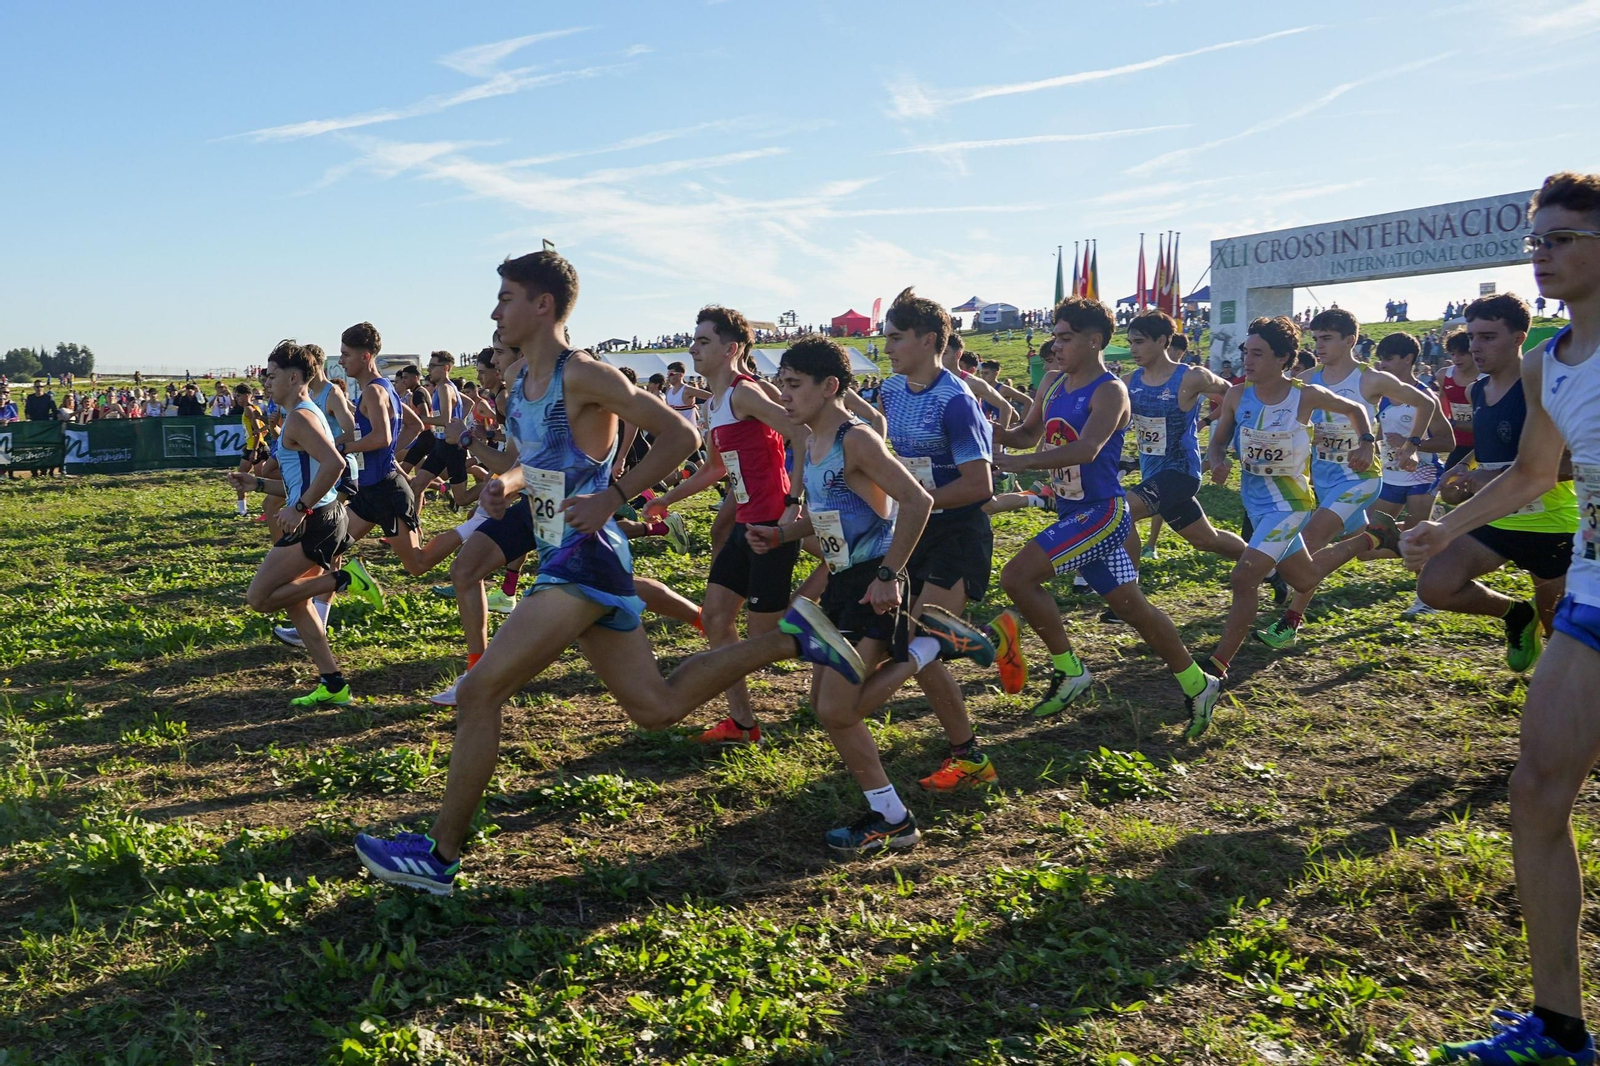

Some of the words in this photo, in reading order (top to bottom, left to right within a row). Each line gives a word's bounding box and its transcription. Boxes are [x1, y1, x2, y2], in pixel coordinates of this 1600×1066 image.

[1215, 242, 1249, 270] XLI
[1254, 231, 1325, 264] CROSS
[1330, 243, 1457, 275] INTERNATIONAL
[1461, 238, 1519, 260] CROSS
[1322, 436, 1352, 450] 3771
[1247, 446, 1283, 461] 3762
[1386, 452, 1396, 462] 3
[1586, 502, 1600, 530] 3
[817, 536, 840, 553] 08
